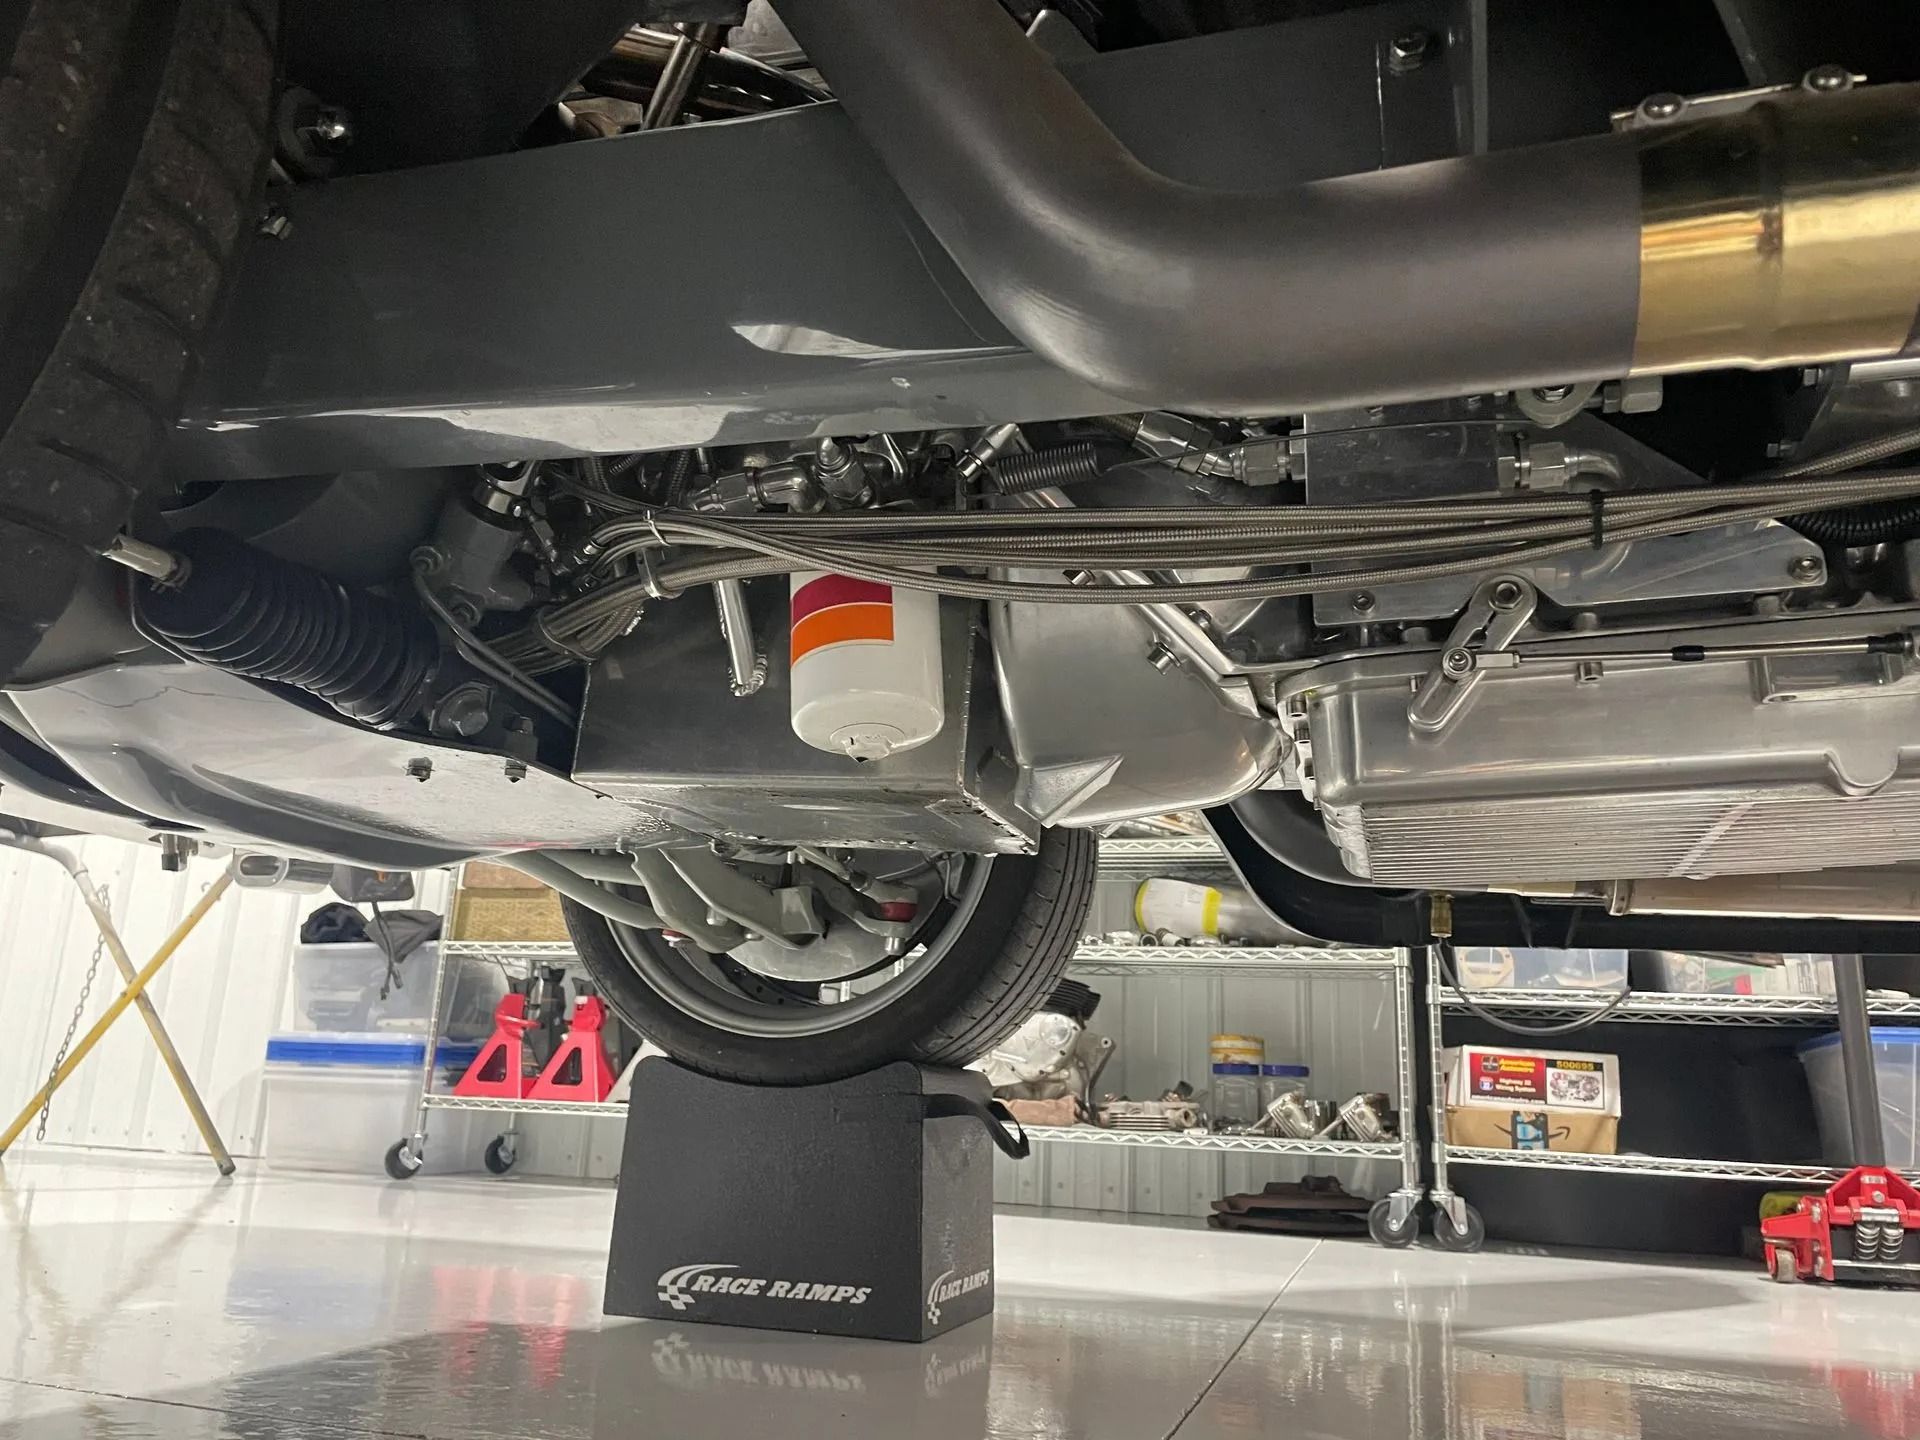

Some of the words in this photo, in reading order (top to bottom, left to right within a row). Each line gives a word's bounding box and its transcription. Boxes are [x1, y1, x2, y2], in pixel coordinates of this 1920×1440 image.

[690, 1274, 767, 1296] RACE
[766, 1280, 872, 1304] RAMPS
[938, 1279, 962, 1303] RACE
[961, 1269, 990, 1295] RAMPS
